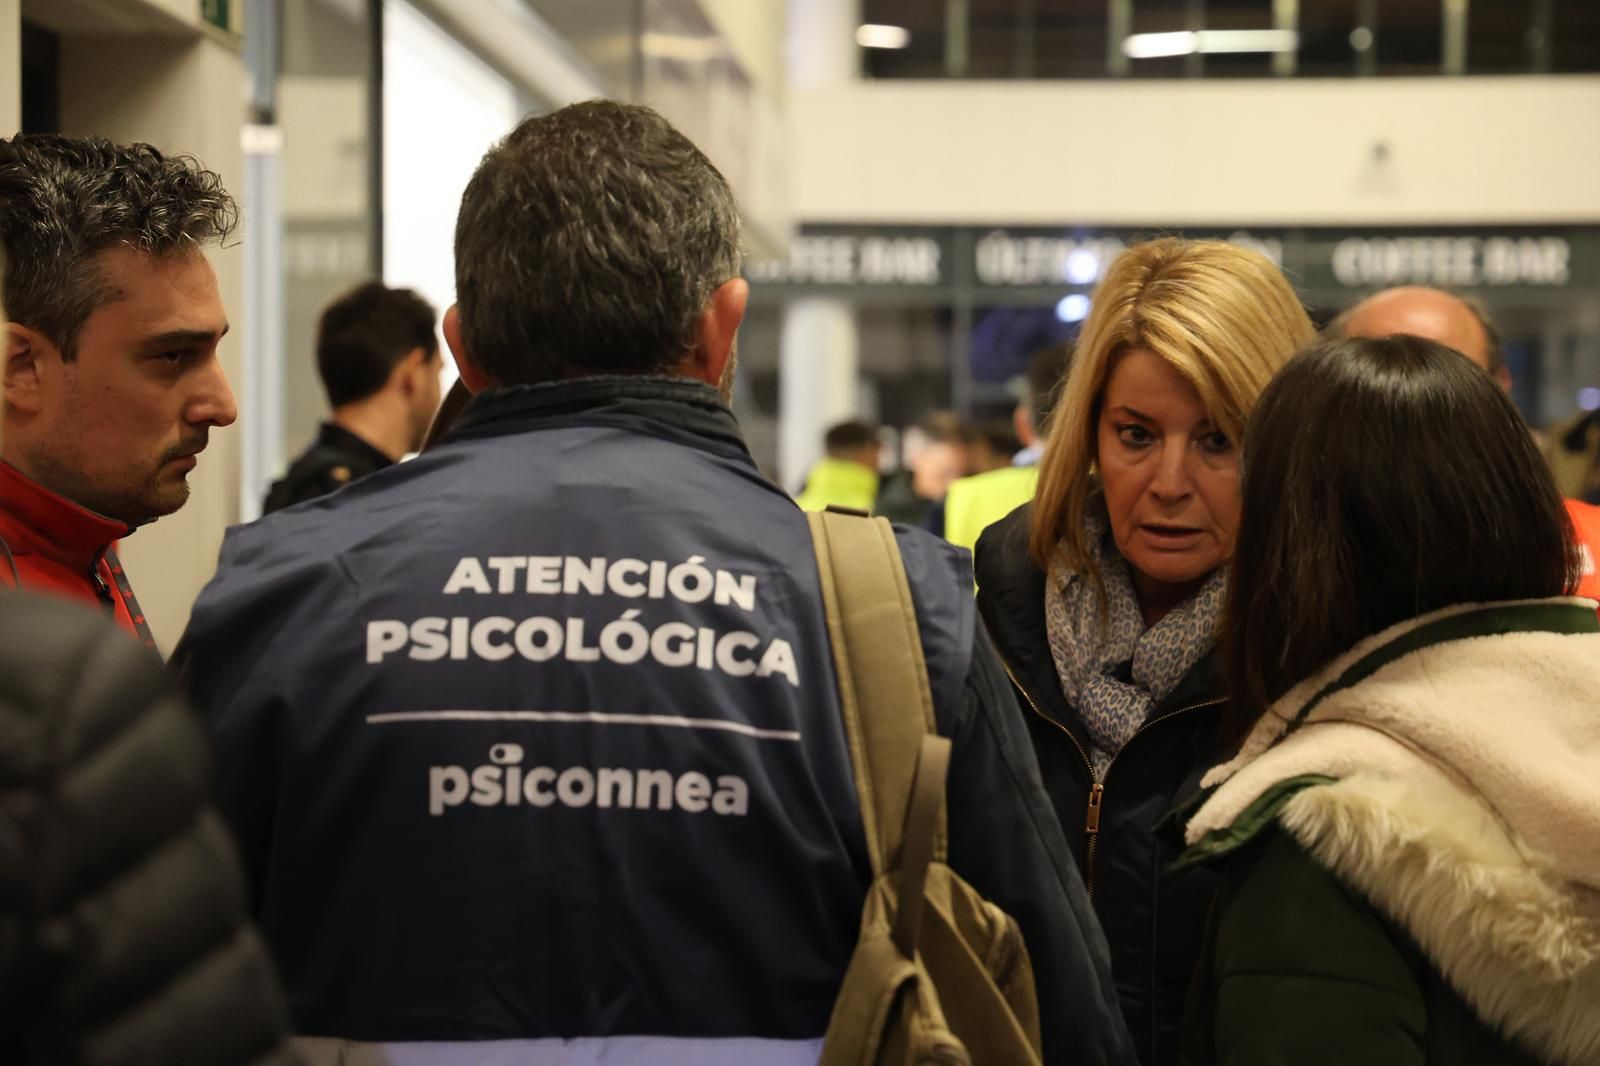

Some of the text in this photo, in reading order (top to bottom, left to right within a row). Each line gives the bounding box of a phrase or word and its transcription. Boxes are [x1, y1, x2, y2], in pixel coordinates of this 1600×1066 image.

[1332, 236, 1479, 286] COFFEE
[1483, 236, 1570, 286] BAR
[442, 555, 757, 612] ATENCIÓN
[365, 608, 800, 687] PSICOLÓGICA
[429, 743, 749, 816] psiconnea
